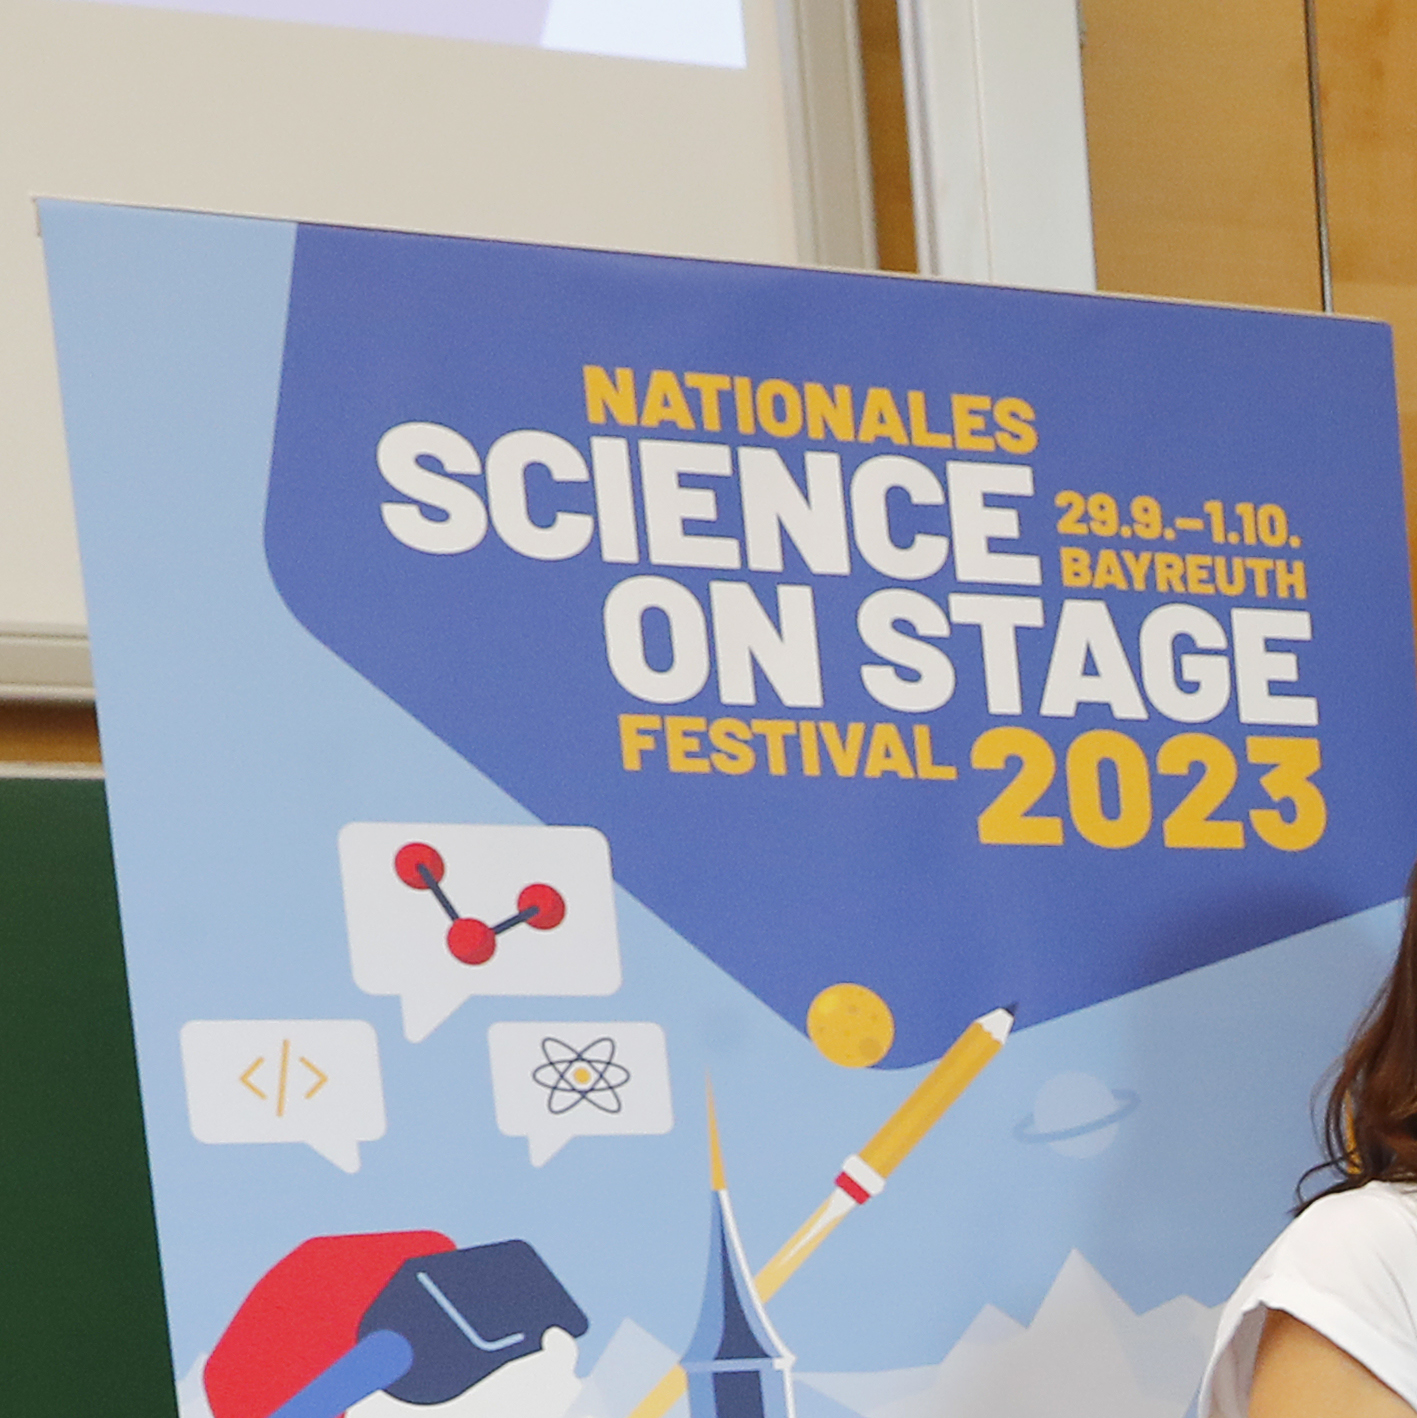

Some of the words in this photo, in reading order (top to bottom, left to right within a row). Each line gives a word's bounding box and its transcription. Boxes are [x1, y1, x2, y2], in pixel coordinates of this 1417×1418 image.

[583, 365, 1038, 453] NATIONALES
[376, 422, 1041, 586] SCIENCE
[1060, 544, 1307, 600] BAYREUTH
[603, 575, 820, 707] ON
[857, 587, 1319, 727] STAGE
[619, 713, 957, 780] FESTIVAL
[971, 725, 1327, 851] 2023
